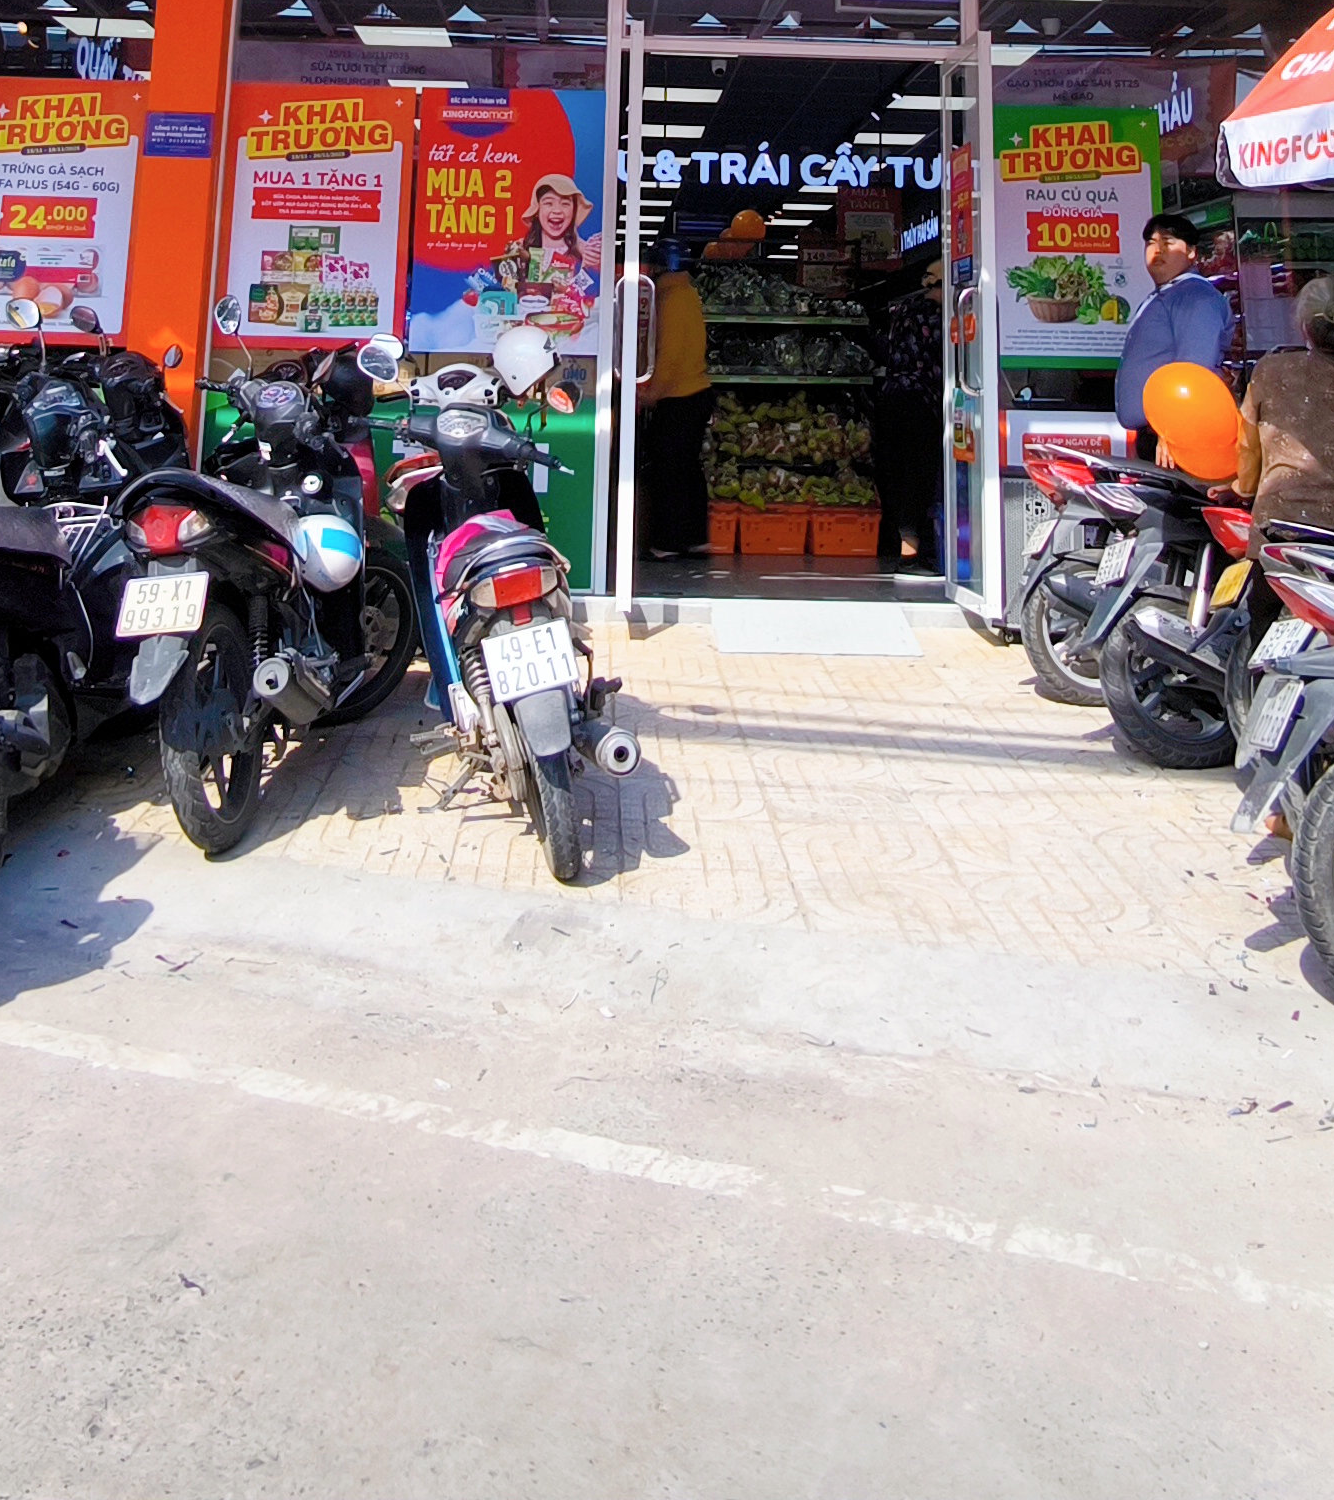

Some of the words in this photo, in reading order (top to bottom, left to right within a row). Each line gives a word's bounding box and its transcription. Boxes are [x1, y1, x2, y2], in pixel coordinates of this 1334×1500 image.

[20, 94, 98, 120] KHAI
[283, 101, 360, 127] KHAI
[250, 124, 389, 152] TRƯƠNG
[1032, 124, 1107, 148] KHAI
[483, 143, 522, 163] kem
[691, 141, 789, 186] TRÁI
[800, 142, 879, 188] CÂY
[1003, 145, 1136, 174] TRƯƠNG
[2, 161, 45, 175] TRỨNG
[48, 162, 67, 176] GÀ
[69, 165, 104, 179] SẠCH
[253, 170, 295, 185] MUA
[302, 173, 312, 185] 1
[317, 168, 367, 190] TẶNG
[373, 174, 383, 188] 1
[426, 167, 485, 197] MUA
[495, 170, 512, 198] 2
[17, 179, 49, 190] PLUS
[52, 180, 80, 192] (54G
[92, 181, 120, 194] 60G)
[1025, 188, 1057, 202] RAU
[1061, 186, 1081, 202] CỦ
[1085, 187, 1119, 204] QUẢ
[9, 204, 88, 230] 24.000
[426, 197, 496, 238] TẶNG
[506, 205, 515, 235] 1
[1037, 222, 1112, 247] 10.000
[136, 580, 192, 605] 59-X1
[123, 603, 197, 631] 993.19
[500, 627, 557, 663] 49-E1
[496, 652, 572, 695] 820.11
